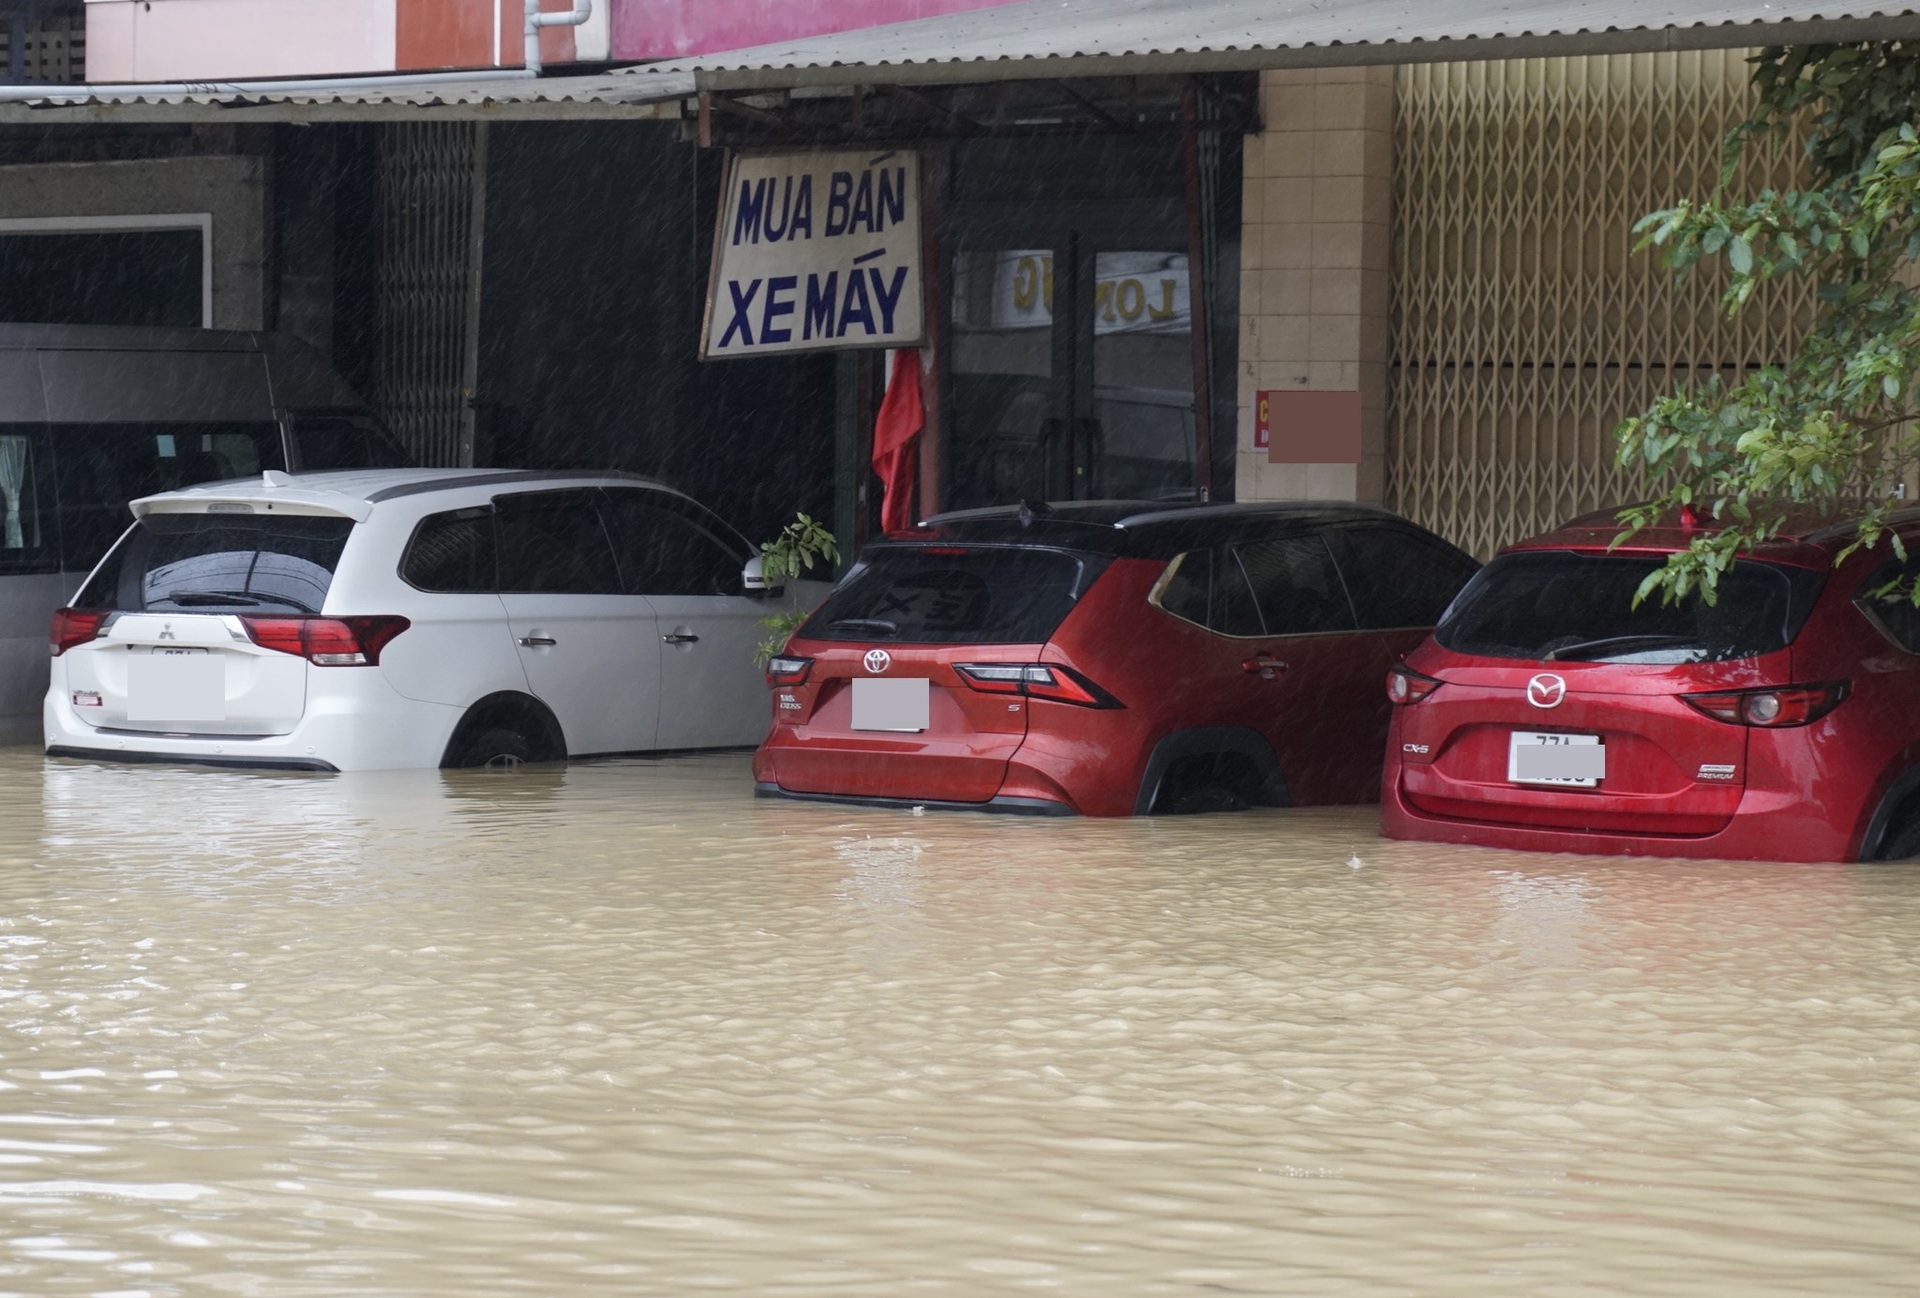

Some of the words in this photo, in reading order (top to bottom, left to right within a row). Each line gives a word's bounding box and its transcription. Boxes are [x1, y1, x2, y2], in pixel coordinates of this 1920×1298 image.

[733, 174, 813, 246] MUA
[825, 151, 906, 238] BÁN
[718, 275, 798, 348] XE
[803, 247, 909, 341] MÁY
[1007, 704, 1021, 712] S
[1402, 743, 1430, 754] CX-5
